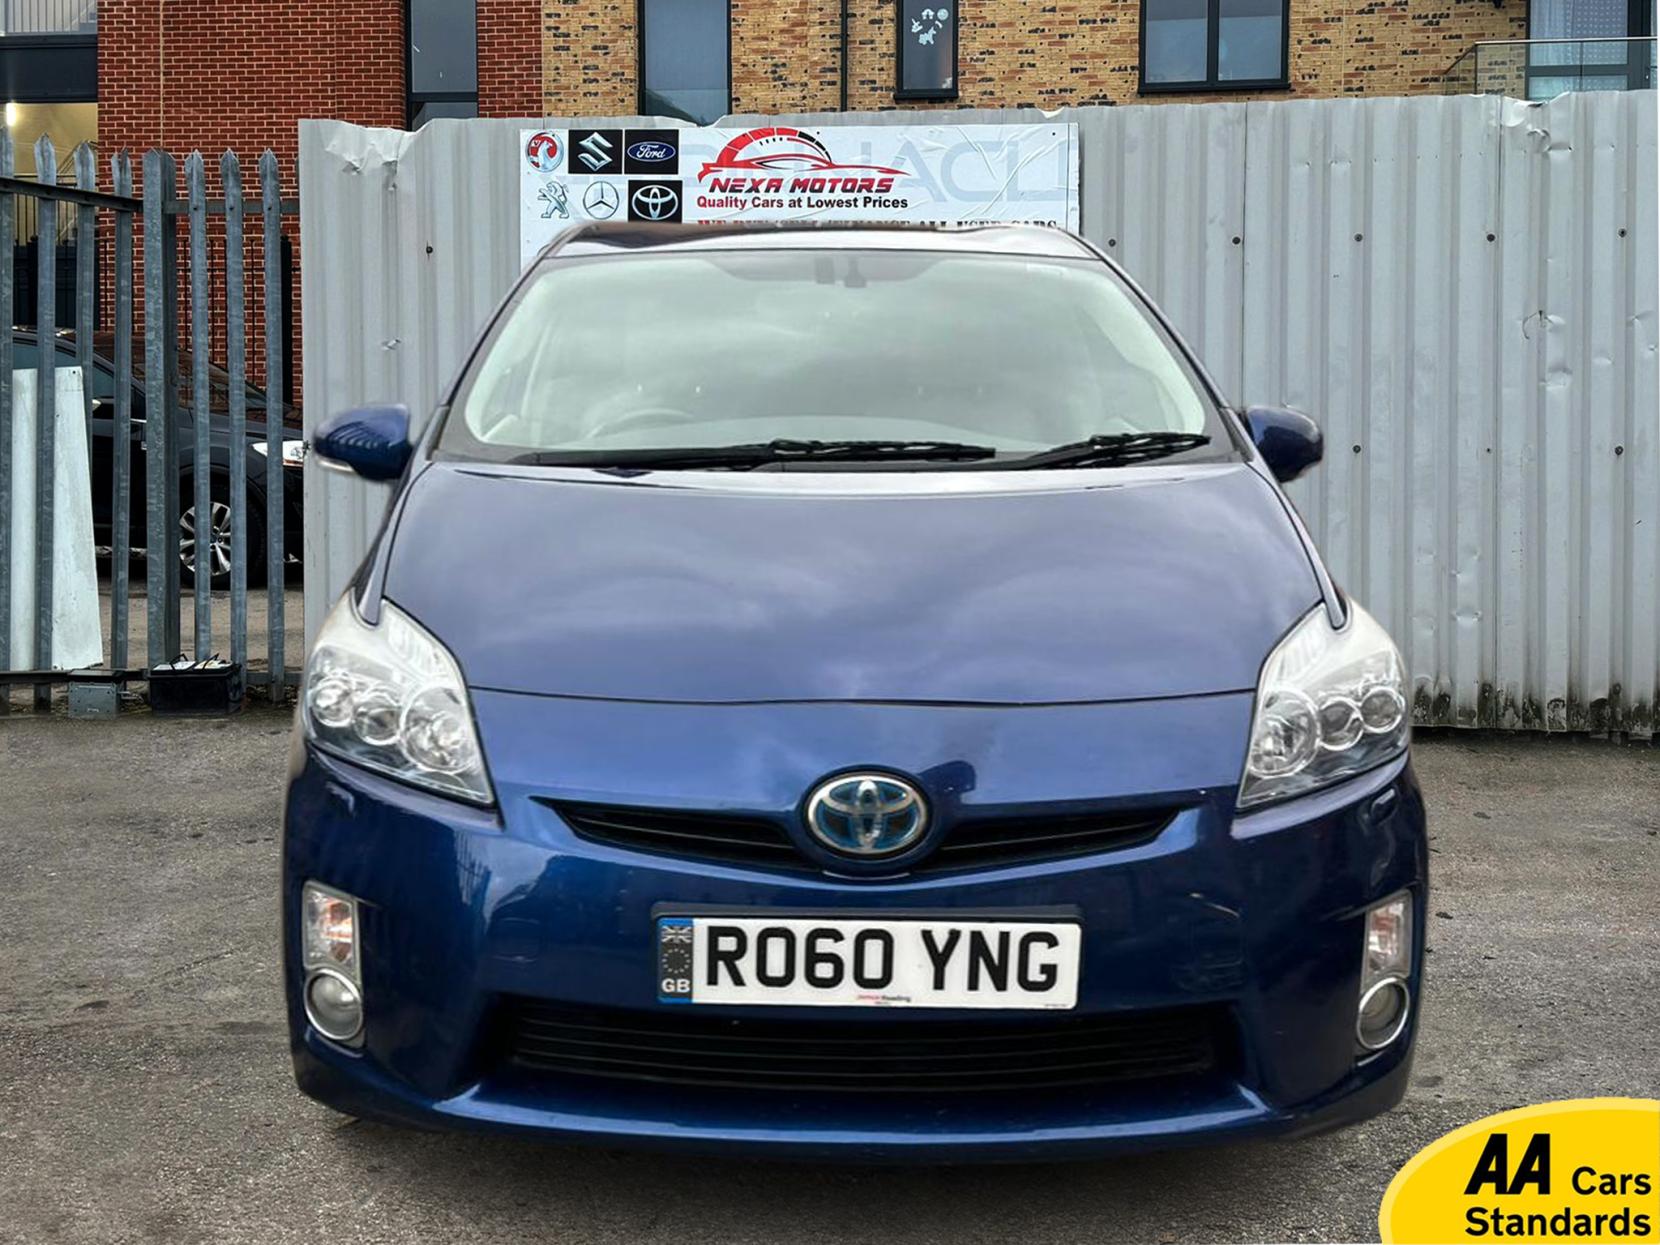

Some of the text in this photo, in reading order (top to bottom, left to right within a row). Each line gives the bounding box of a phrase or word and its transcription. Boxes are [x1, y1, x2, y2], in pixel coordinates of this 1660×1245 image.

[636, 144, 666, 158] Ford
[709, 178, 895, 193] NEXA MOTORS
[697, 196, 908, 210] Quality Cars at Lowest Prices
[706, 925, 1060, 992] RO60 YNG
[661, 978, 691, 993] GB
